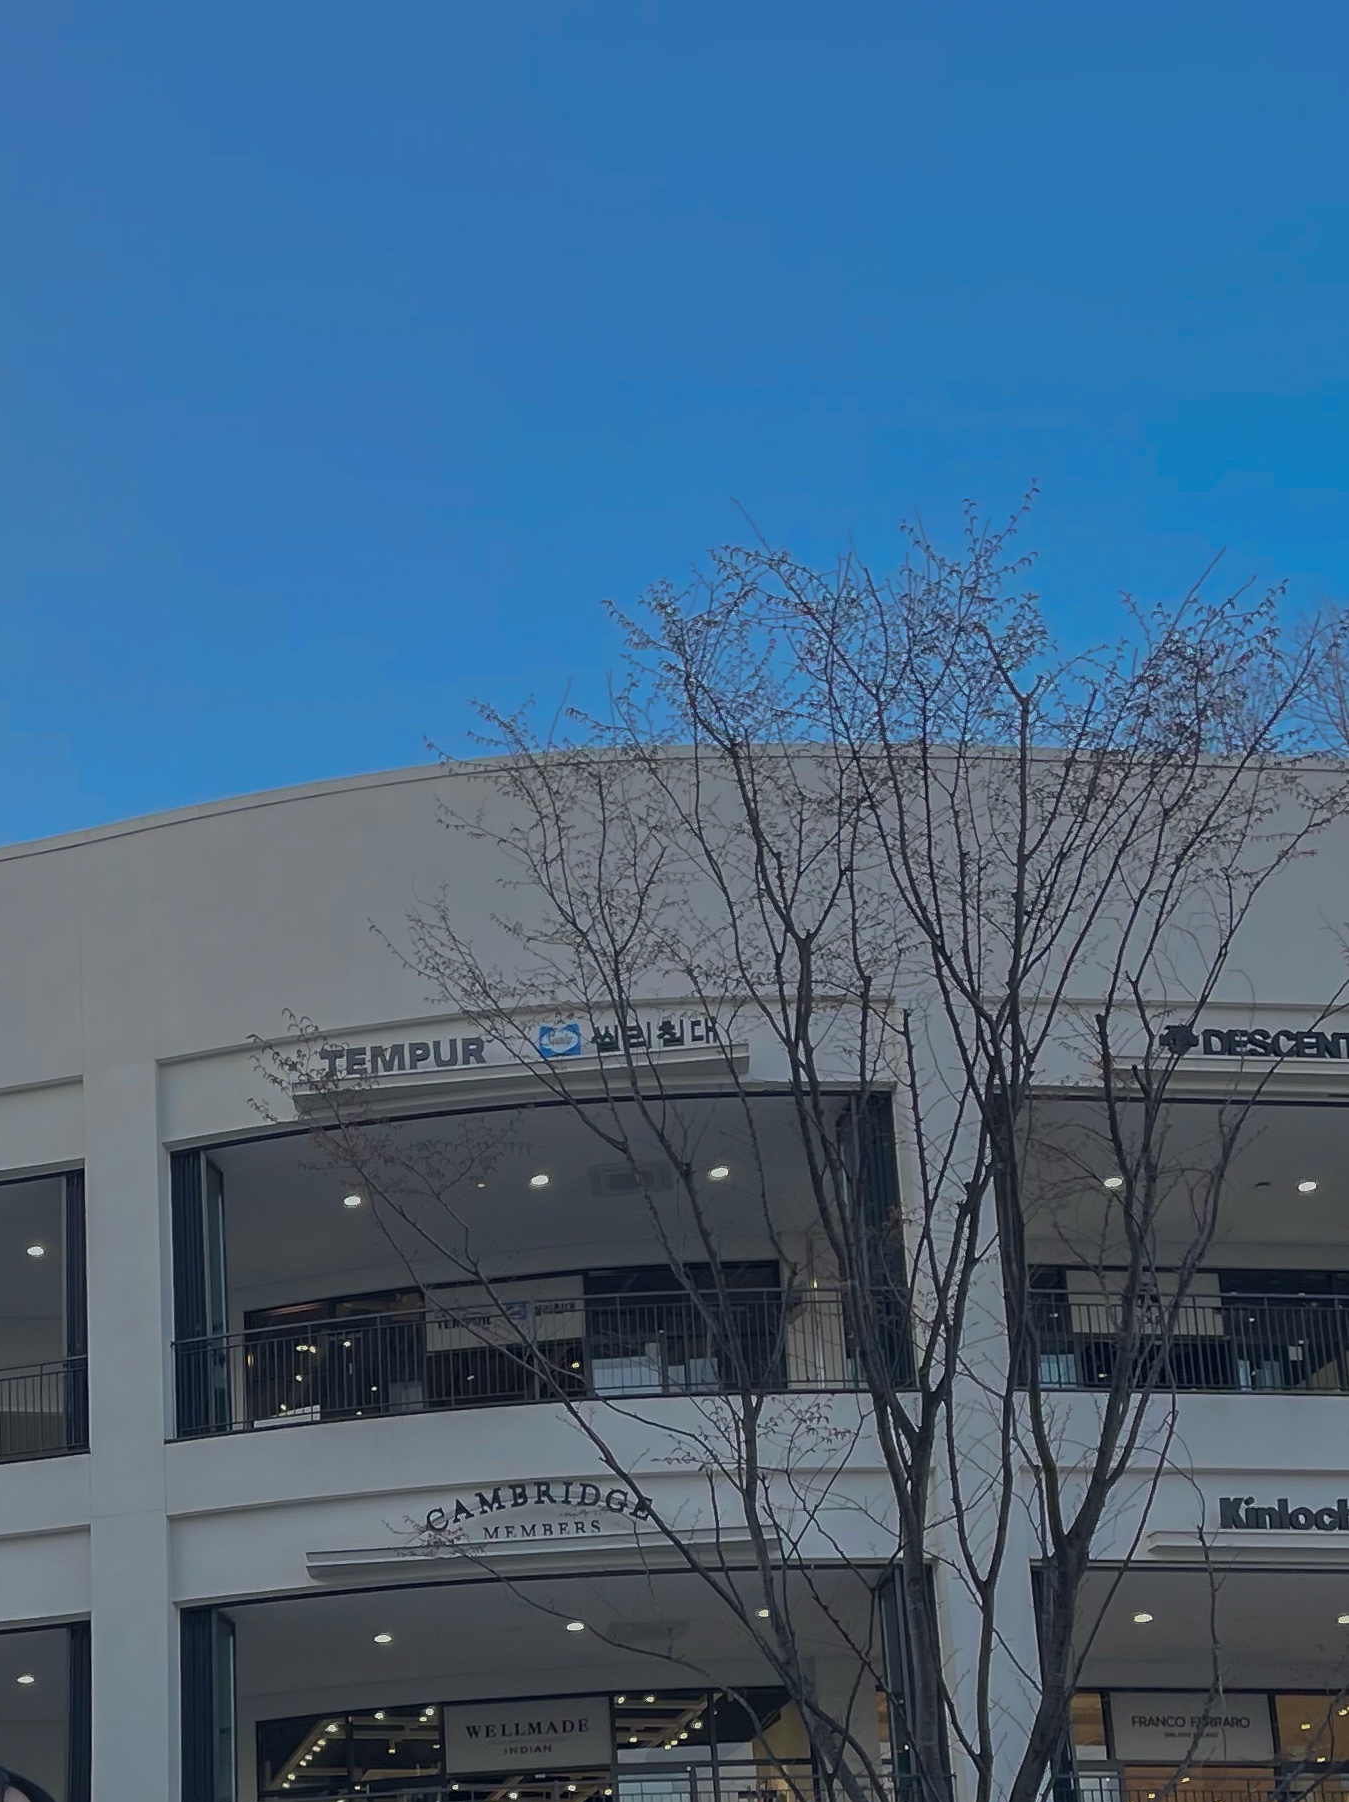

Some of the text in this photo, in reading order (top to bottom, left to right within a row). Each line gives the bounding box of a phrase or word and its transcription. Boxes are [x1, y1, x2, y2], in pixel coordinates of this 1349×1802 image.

[591, 1018, 717, 1052] 씰리침대
[319, 1036, 487, 1077] TEMPUR
[426, 1481, 653, 1532] CAMBRIDGE
[483, 1520, 601, 1540] MEMBERS
[466, 1718, 589, 1739] WELLMADE
[1132, 1715, 1186, 1727] FRANCO
[505, 1744, 552, 1755] INDIAN
